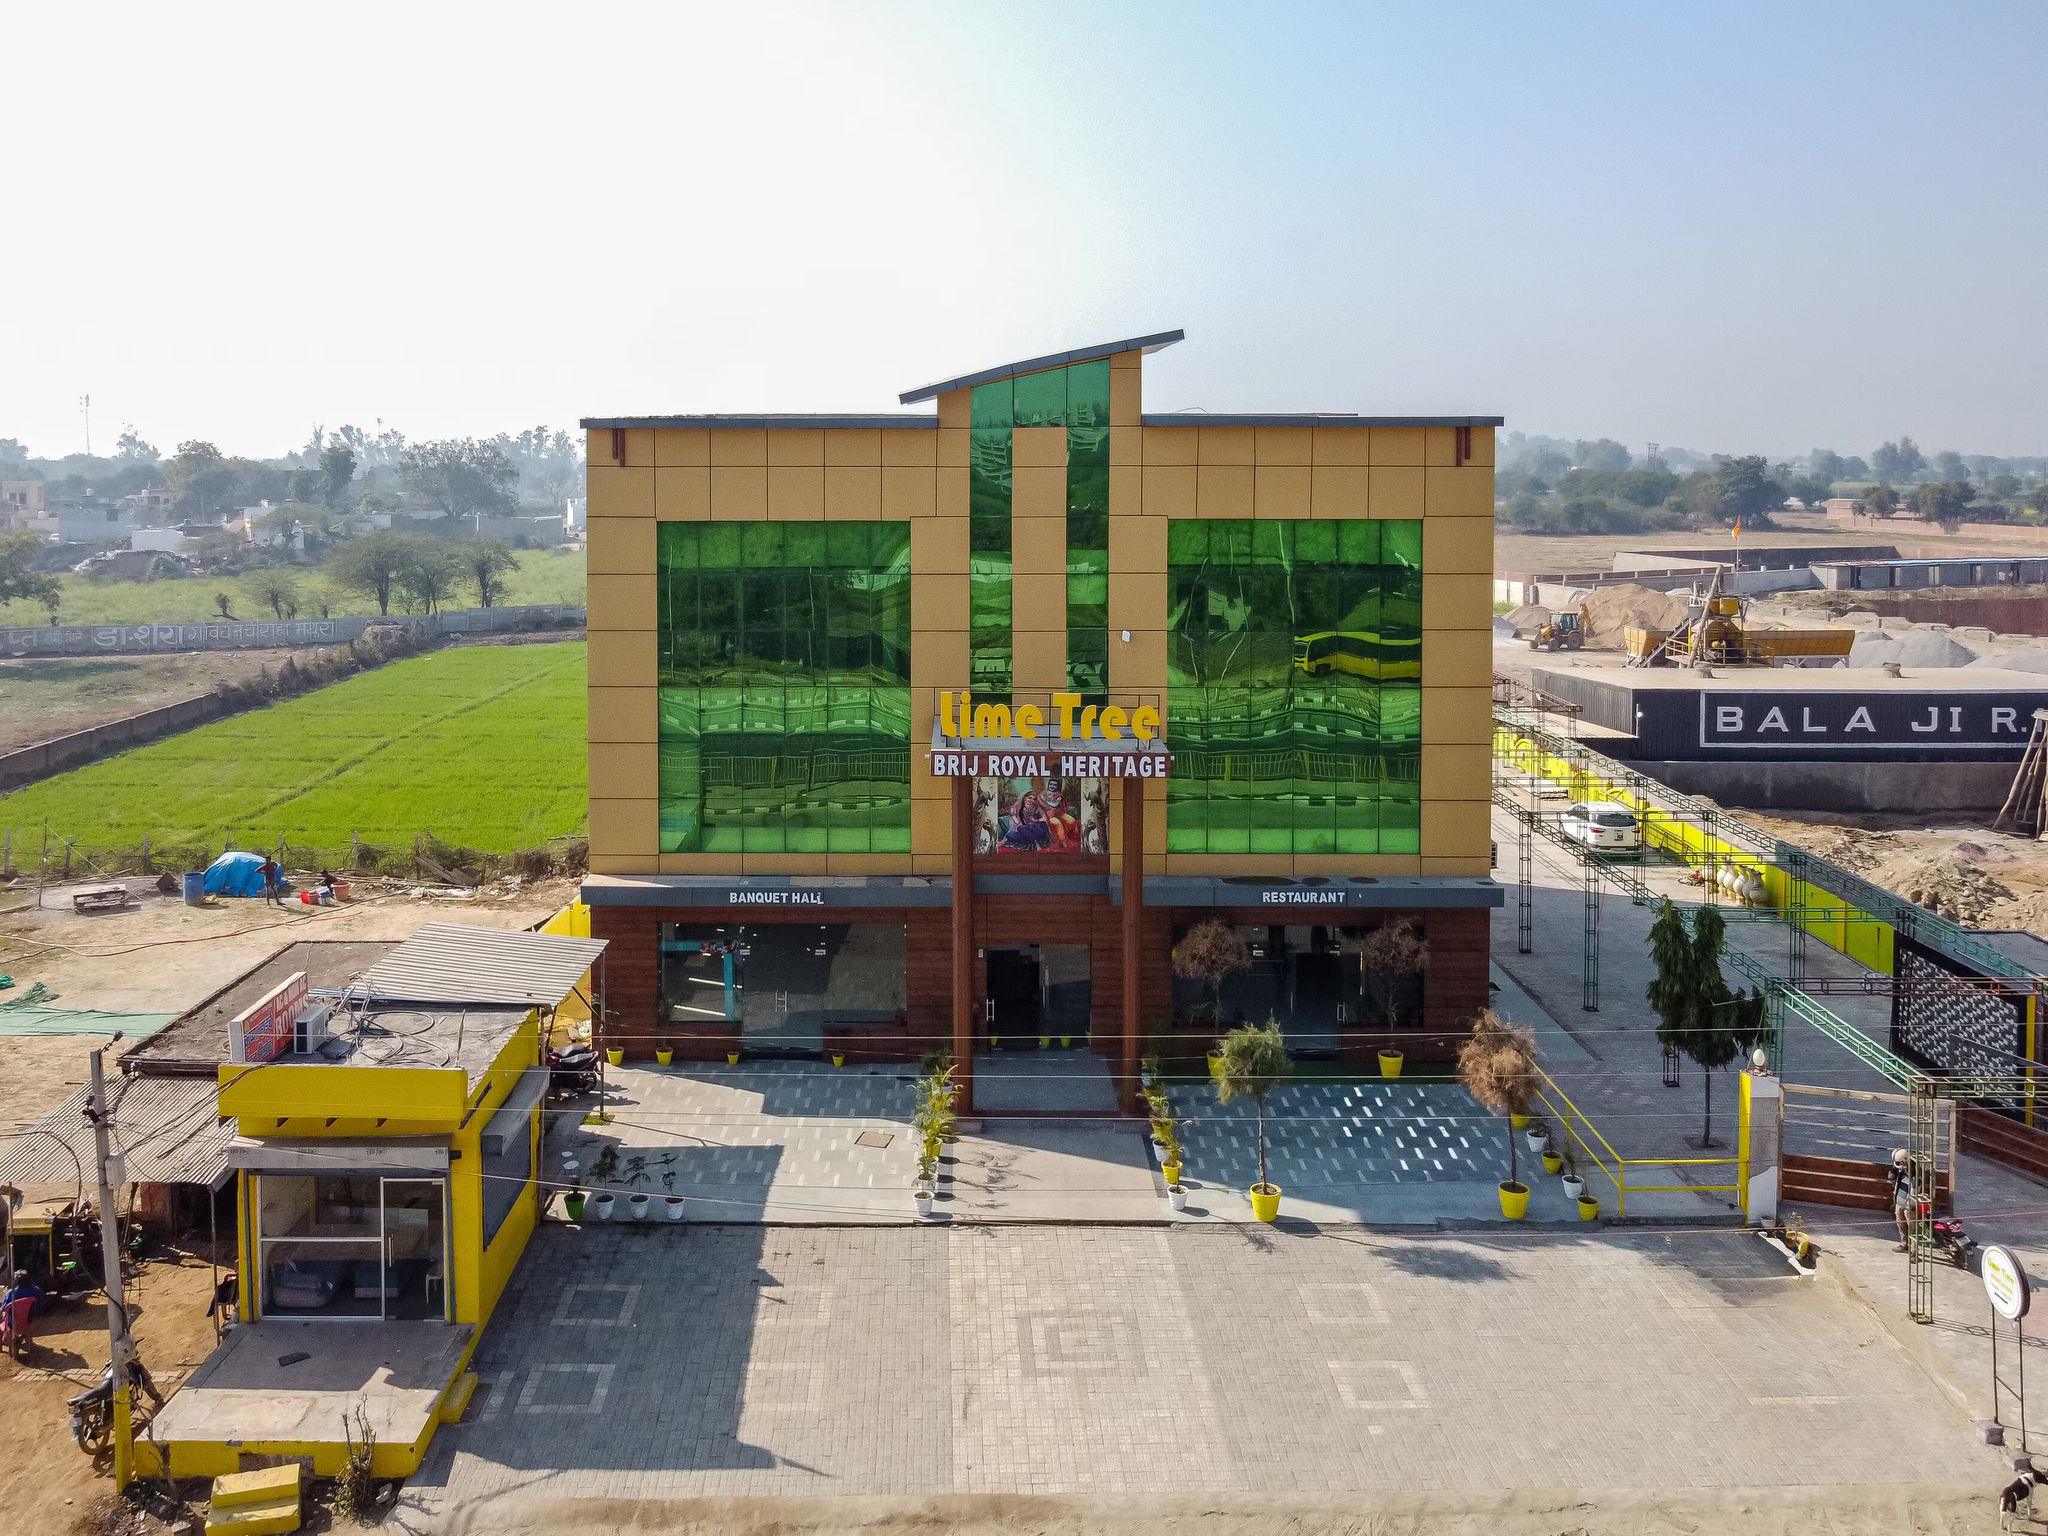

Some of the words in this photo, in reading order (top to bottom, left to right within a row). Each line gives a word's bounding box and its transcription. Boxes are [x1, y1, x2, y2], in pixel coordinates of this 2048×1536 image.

[1052, 692, 1160, 740] Tree
[1716, 706, 1876, 733] BALA
[1911, 706, 1962, 733] JI
[1991, 707, 2044, 733] R.
[934, 754, 979, 776] BRIJ
[988, 754, 1050, 777] ROYAL
[1061, 755, 1166, 778] HERITAGE
[729, 891, 789, 904] BANQUET
[791, 891, 824, 905] HALL
[1262, 891, 1346, 904] RESTAURANT
